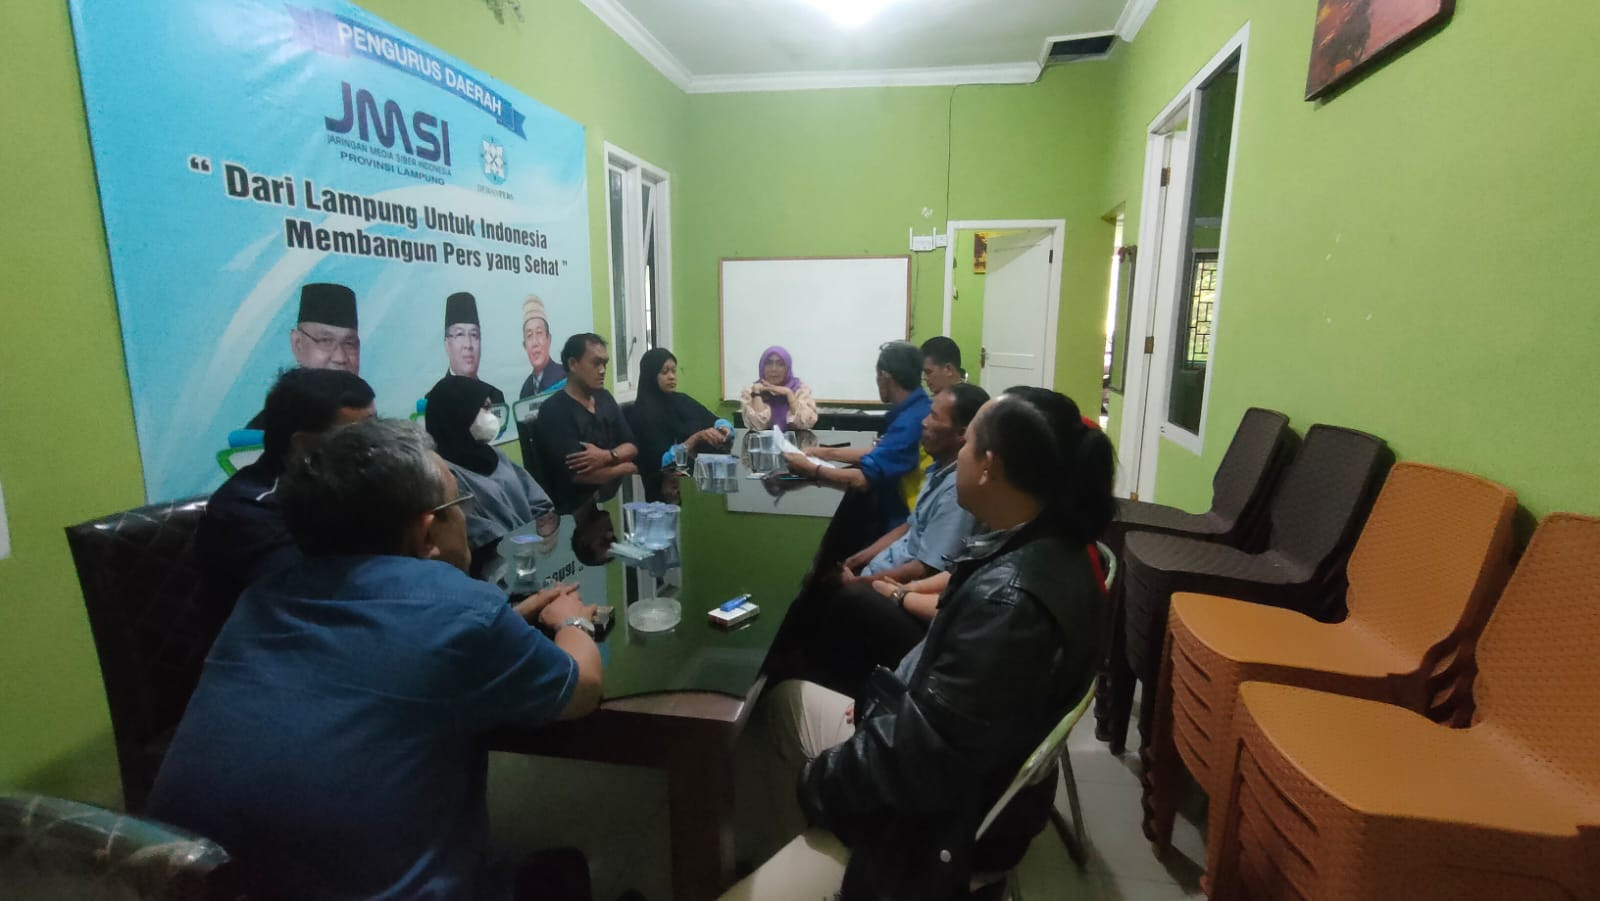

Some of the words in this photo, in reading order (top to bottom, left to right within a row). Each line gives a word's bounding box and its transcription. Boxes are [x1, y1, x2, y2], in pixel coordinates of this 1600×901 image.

[337, 22, 441, 81] PENGURUS
[445, 67, 502, 116] DAERAH
[325, 81, 452, 167] JMSI
[327, 134, 368, 153] JARINGAN
[369, 145, 394, 160] MEDIA
[395, 153, 417, 166] SIBER
[340, 151, 395, 172] PROVINSI
[397, 167, 445, 185] LAMPUNG
[225, 164, 296, 207] Dari
[304, 180, 418, 229] Lampung
[424, 205, 476, 237] Untuk
[480, 218, 548, 249] Indonesia
[285, 219, 437, 263] Membangun
[443, 242, 482, 267] Pers
[486, 252, 520, 274] yang
[525, 254, 559, 276] Sehat
